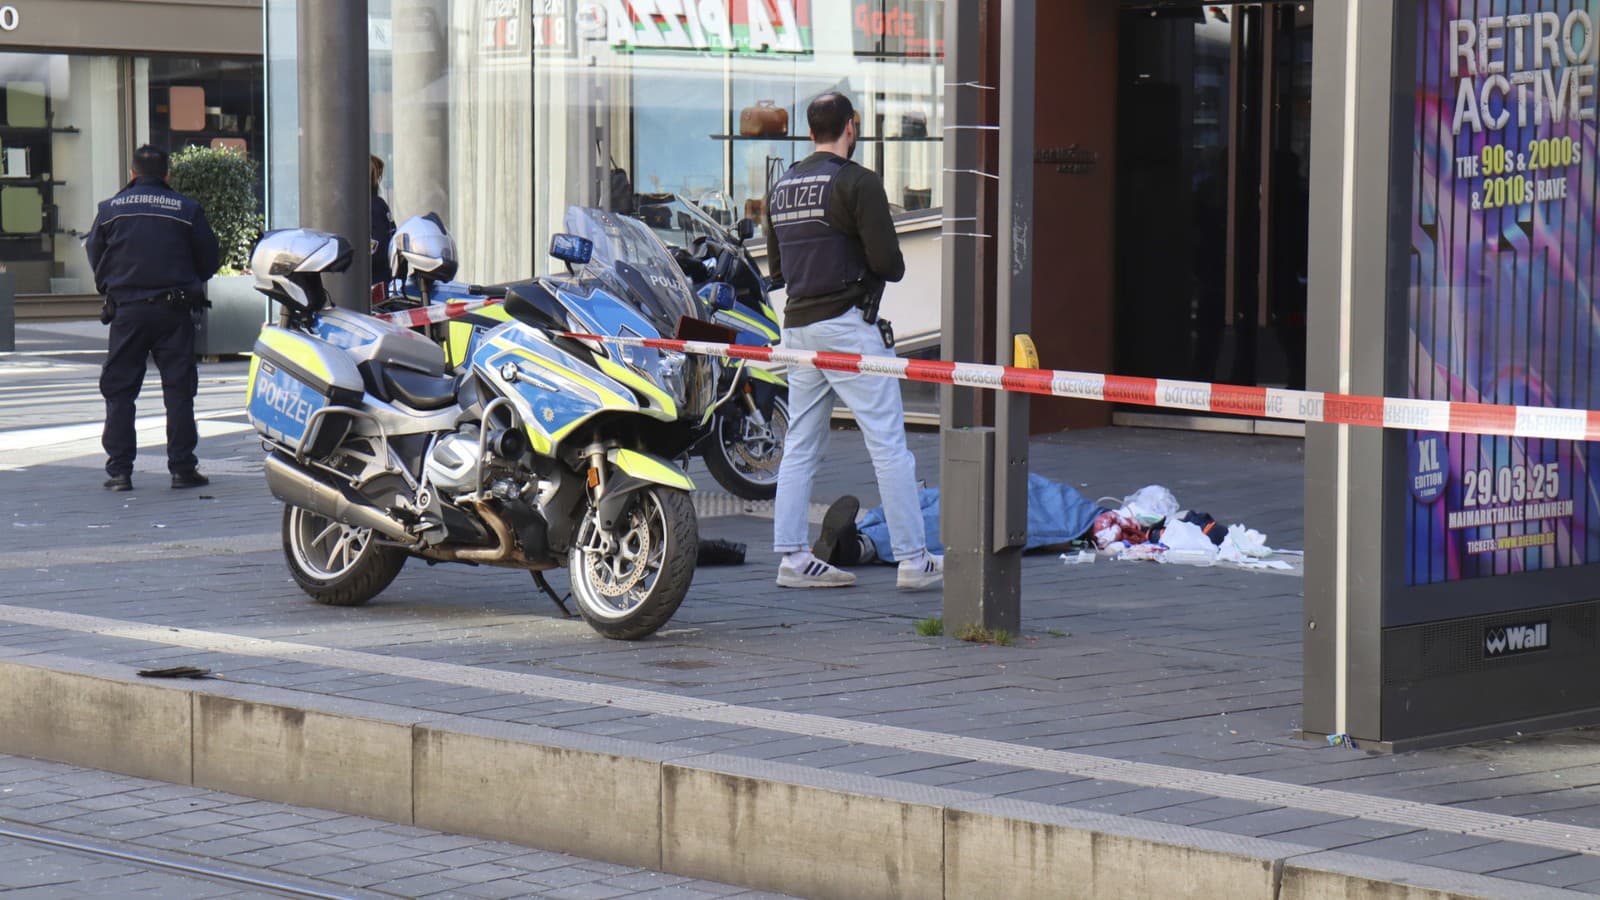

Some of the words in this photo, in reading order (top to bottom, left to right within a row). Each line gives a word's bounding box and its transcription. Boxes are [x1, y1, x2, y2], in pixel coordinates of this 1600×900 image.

[1450, 9, 1593, 78] RETRO
[1452, 64, 1595, 135] ACTIVE
[1456, 155, 1479, 178] THE
[1482, 144, 1514, 175] 90S
[1517, 153, 1526, 171] &
[1528, 136, 1581, 170] 2000S
[110, 194, 182, 207] POLIZEIBEHÖRDE
[770, 184, 825, 214] POLIZEI
[1472, 192, 1481, 210] &
[1483, 175, 1534, 209] 2010S
[1537, 177, 1567, 200] RAVE
[1419, 438, 1440, 472] XL
[1415, 471, 1443, 489] EDITION
[1463, 463, 1560, 506] 29.03.25
[1449, 505, 1523, 528] MAIMARKTHALLE
[1525, 500, 1573, 520] MANNHEIM
[1505, 623, 1548, 650] Wall
